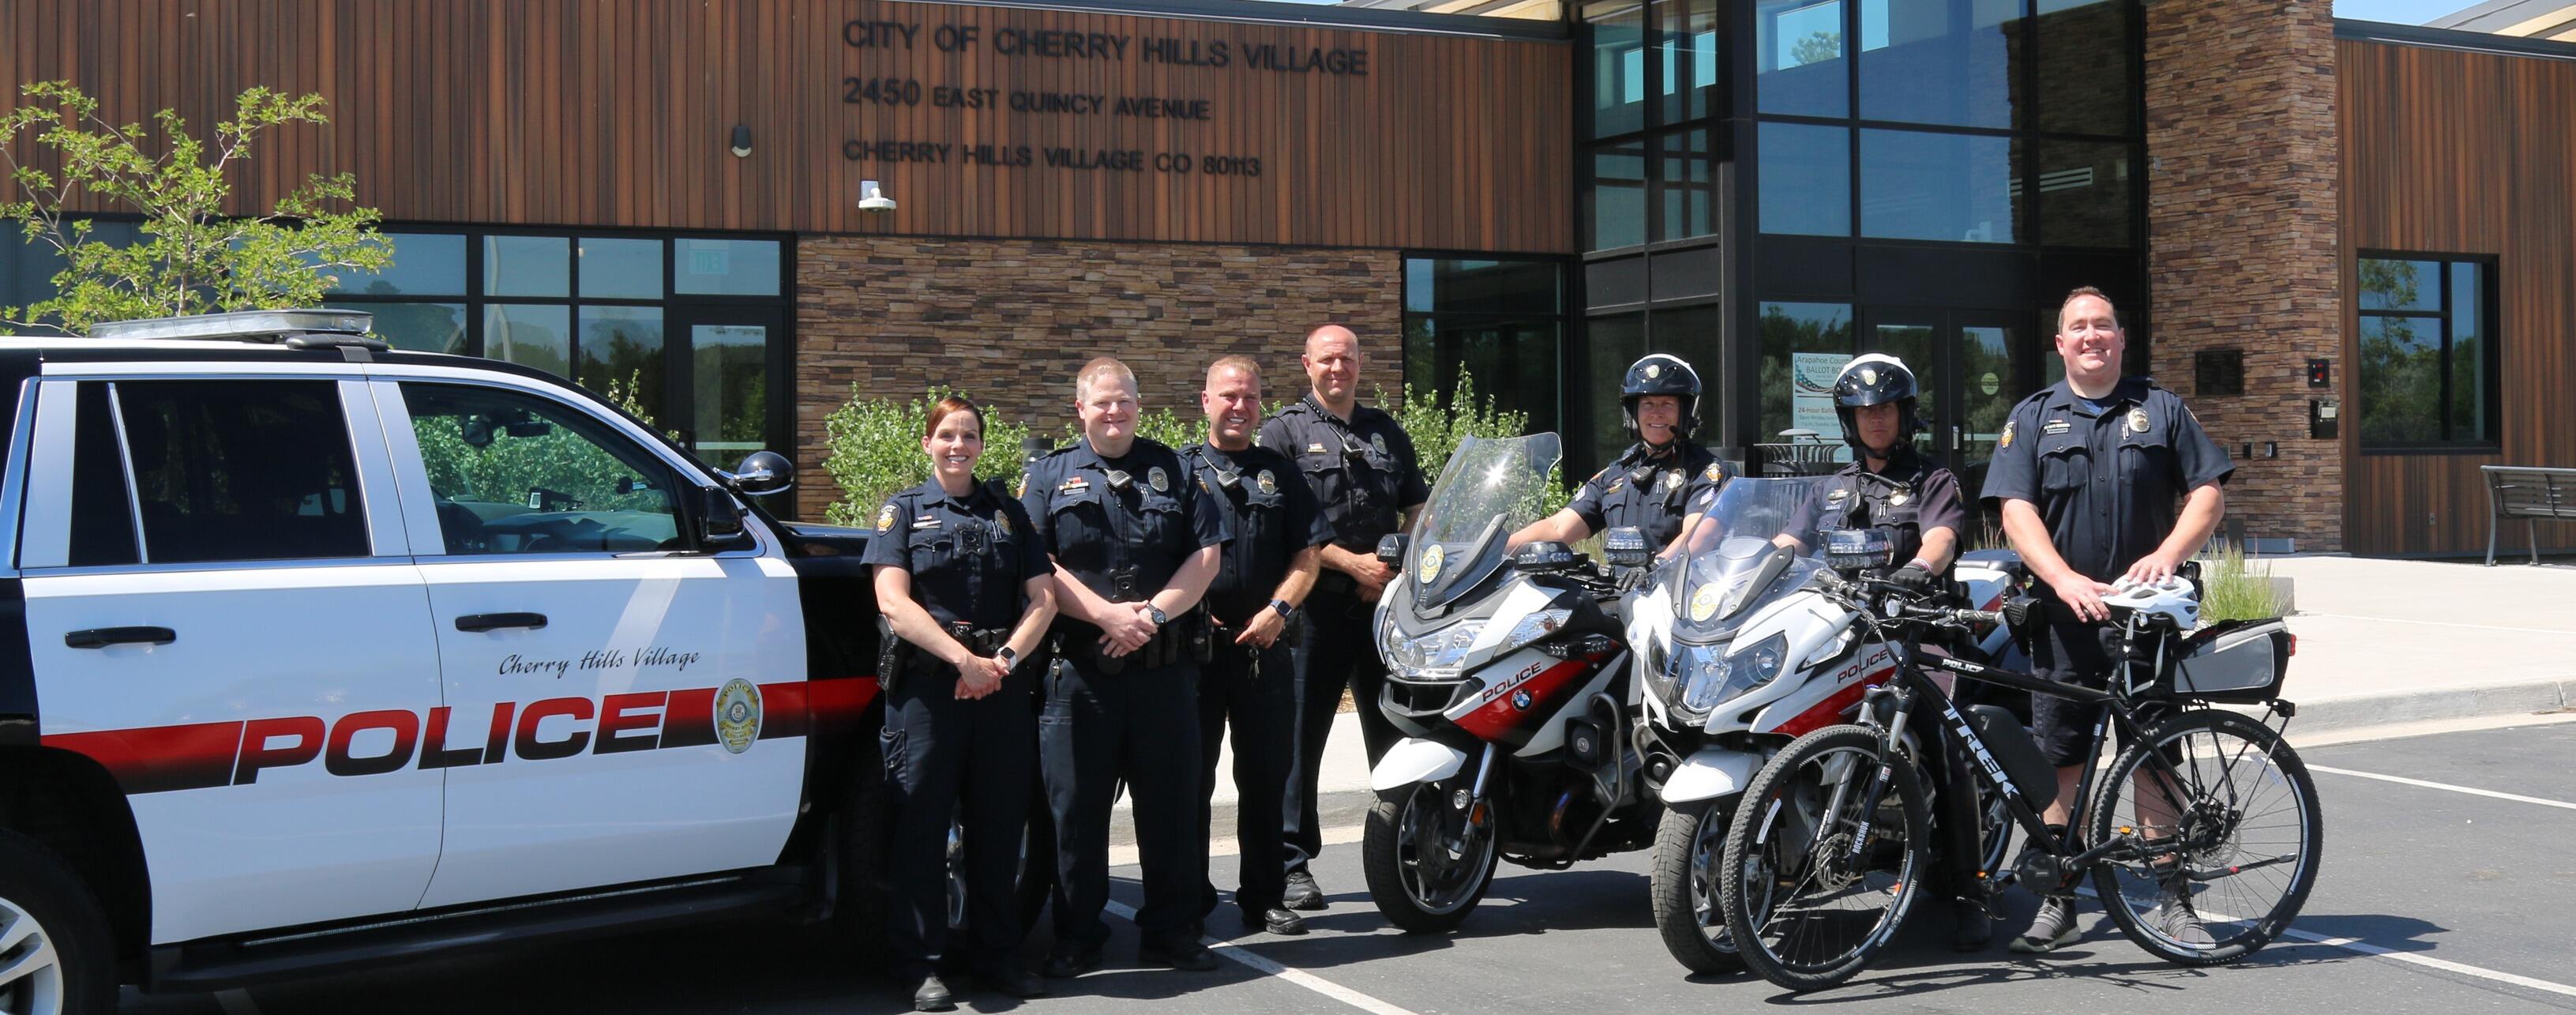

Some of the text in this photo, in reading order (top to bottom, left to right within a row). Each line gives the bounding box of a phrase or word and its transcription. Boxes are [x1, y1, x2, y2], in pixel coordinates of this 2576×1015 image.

[844, 21, 1369, 77] CITY OF CHERRY HILLS VILLAGE
[844, 77, 1211, 120] 2450 EAST QUINCY AVENUE
[844, 139, 1261, 176] CHERRY HILLS VILLAGE CO 80113
[1797, 355, 1829, 364] Arapahoe
[498, 646, 700, 679] Cherry Hills Village
[1482, 661, 1541, 702] POLICE
[1838, 648, 1888, 684] POLICE
[232, 690, 668, 786] POLICE
[1943, 698, 2021, 800] TREK
[1852, 821, 1870, 855] ROCKSHOX
